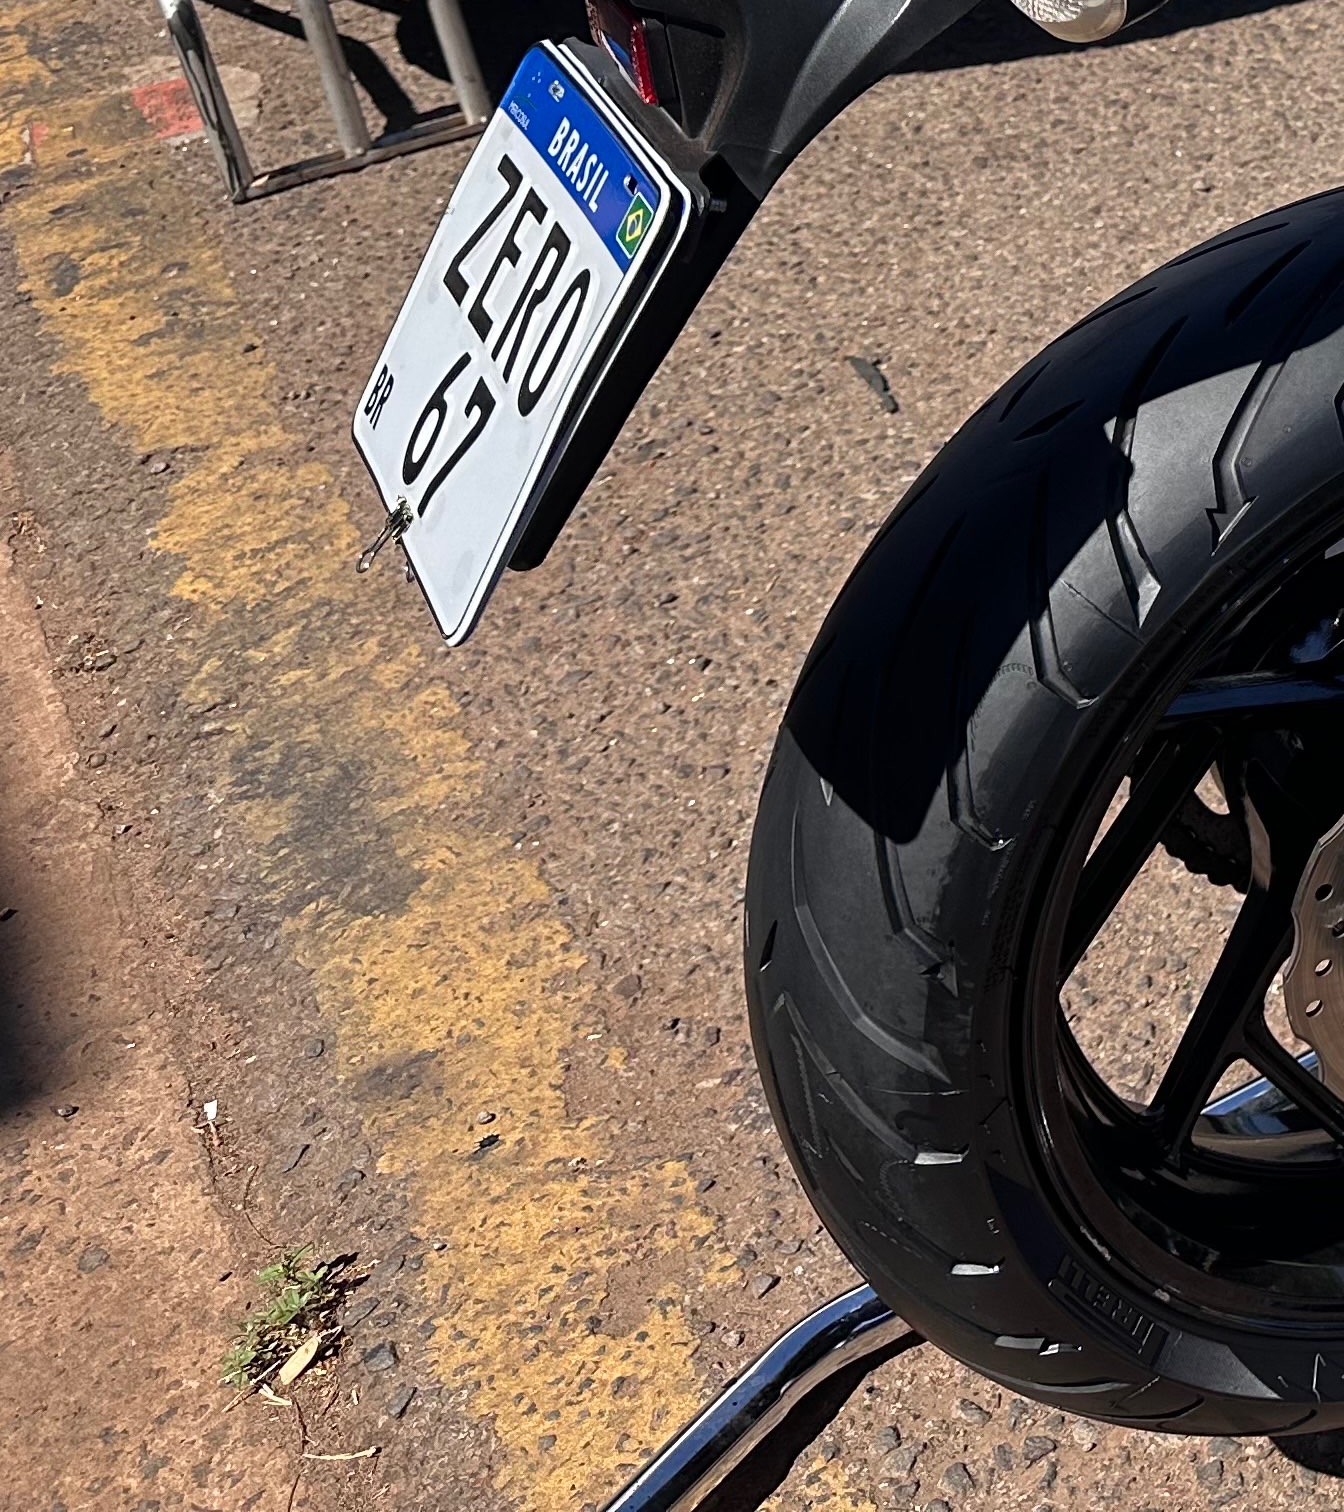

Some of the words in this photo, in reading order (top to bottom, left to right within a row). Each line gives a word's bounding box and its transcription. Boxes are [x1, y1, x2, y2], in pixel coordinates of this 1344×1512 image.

[547, 116, 609, 214] BRASIL
[442, 153, 591, 418] ZERO
[364, 364, 396, 432] BR
[403, 352, 497, 519] 67
